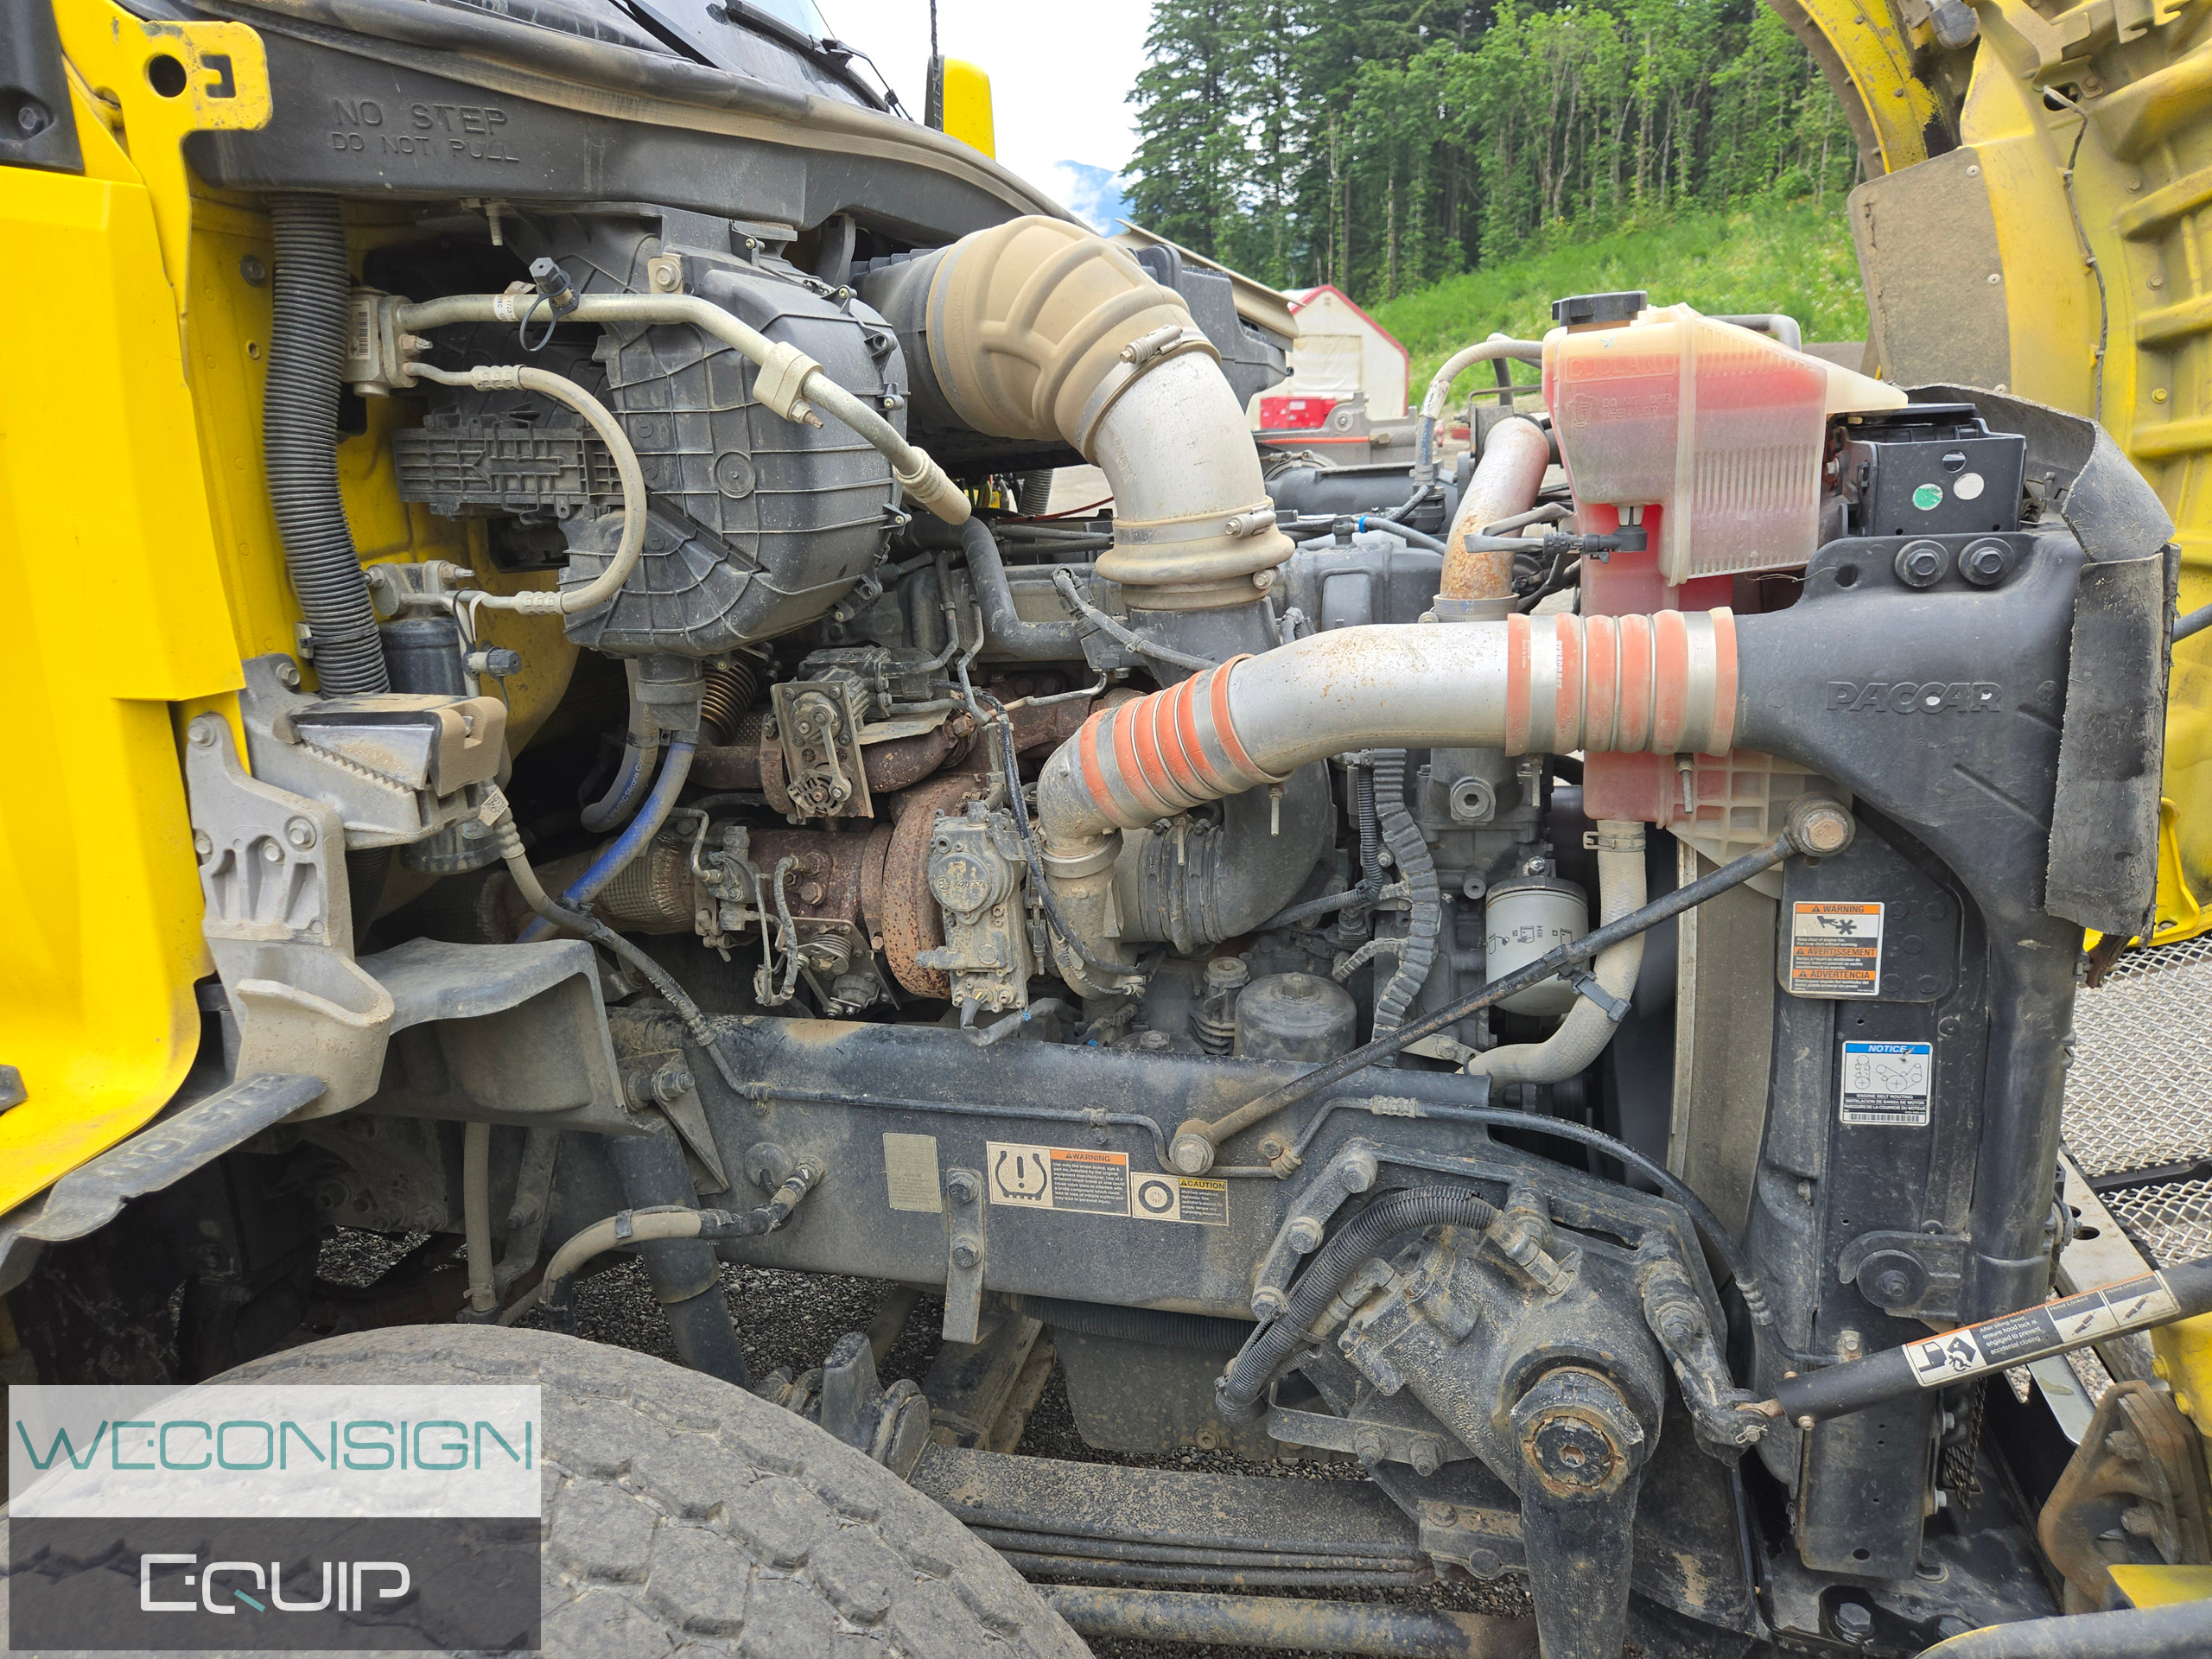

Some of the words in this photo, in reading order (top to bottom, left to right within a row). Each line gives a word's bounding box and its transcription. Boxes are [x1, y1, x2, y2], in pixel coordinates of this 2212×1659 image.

[332, 99, 383, 126] NO
[410, 103, 508, 135] STEP
[332, 132, 364, 150] DO
[380, 135, 429, 155] NOT
[449, 138, 519, 162] PULL
[1569, 353, 1670, 378] COOLANT
[1602, 397, 1617, 407] DO
[1623, 396, 1643, 405] NOT
[1649, 393, 1676, 404] OPEN
[1827, 682, 2002, 715] PACCAR
[1072, 1153, 1109, 1161] WARNING
[1187, 1180, 1224, 1189] CAUTION
[2123, 1277, 2152, 1288] Unlocked
[2066, 1296, 2088, 1306] Locked
[1982, 1330, 2002, 1338] ensure
[2002, 1325, 2018, 1333] hood
[1985, 1334, 2012, 1347] engaged
[2018, 1325, 2041, 1337] prevent
[1989, 1341, 2019, 1354] accidental
